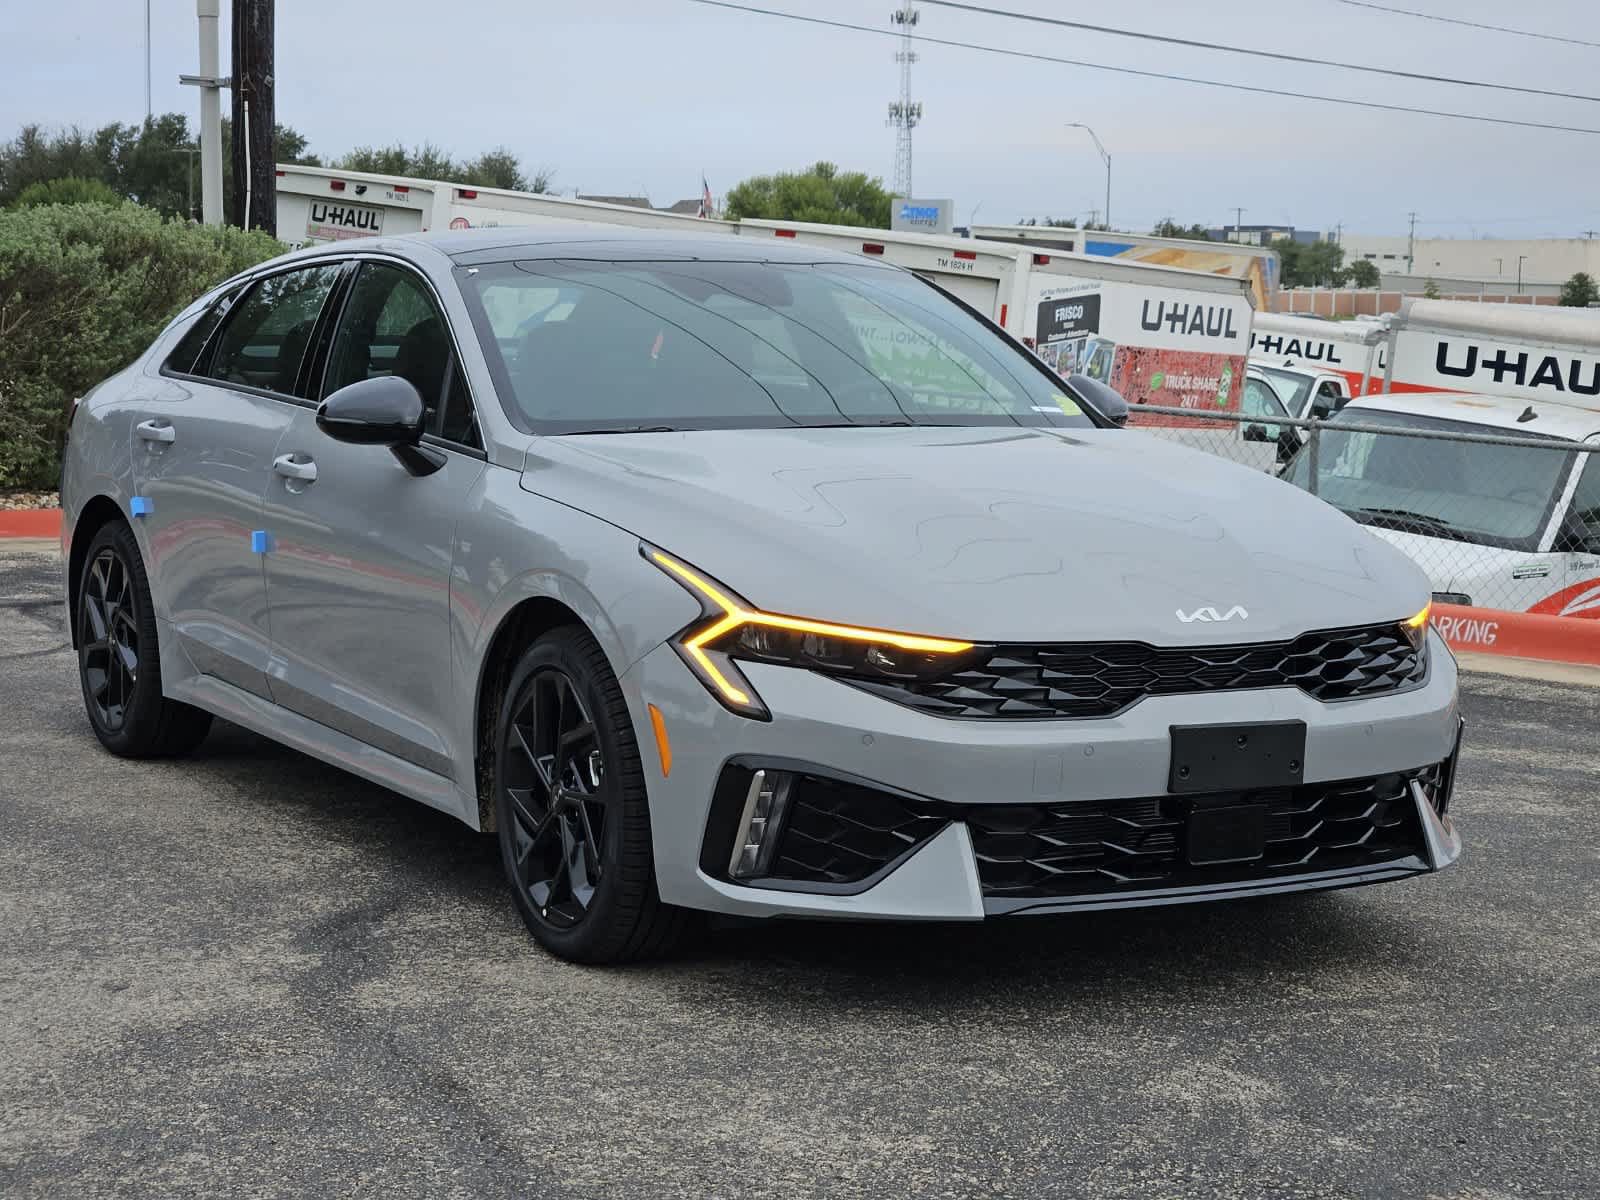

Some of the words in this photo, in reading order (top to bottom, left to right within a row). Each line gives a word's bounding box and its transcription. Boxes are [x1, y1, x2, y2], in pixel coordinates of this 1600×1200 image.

[312, 204, 379, 231] U-HAUL
[1055, 304, 1084, 322] FRISCO
[1142, 299, 1237, 338] U-HAUL
[1436, 342, 1600, 395] U-HAU
[1165, 375, 1192, 390] TRUCK
[1192, 376, 1219, 392] SHARE
[1175, 605, 1249, 623] KIA
[1430, 616, 1498, 645] RKING
